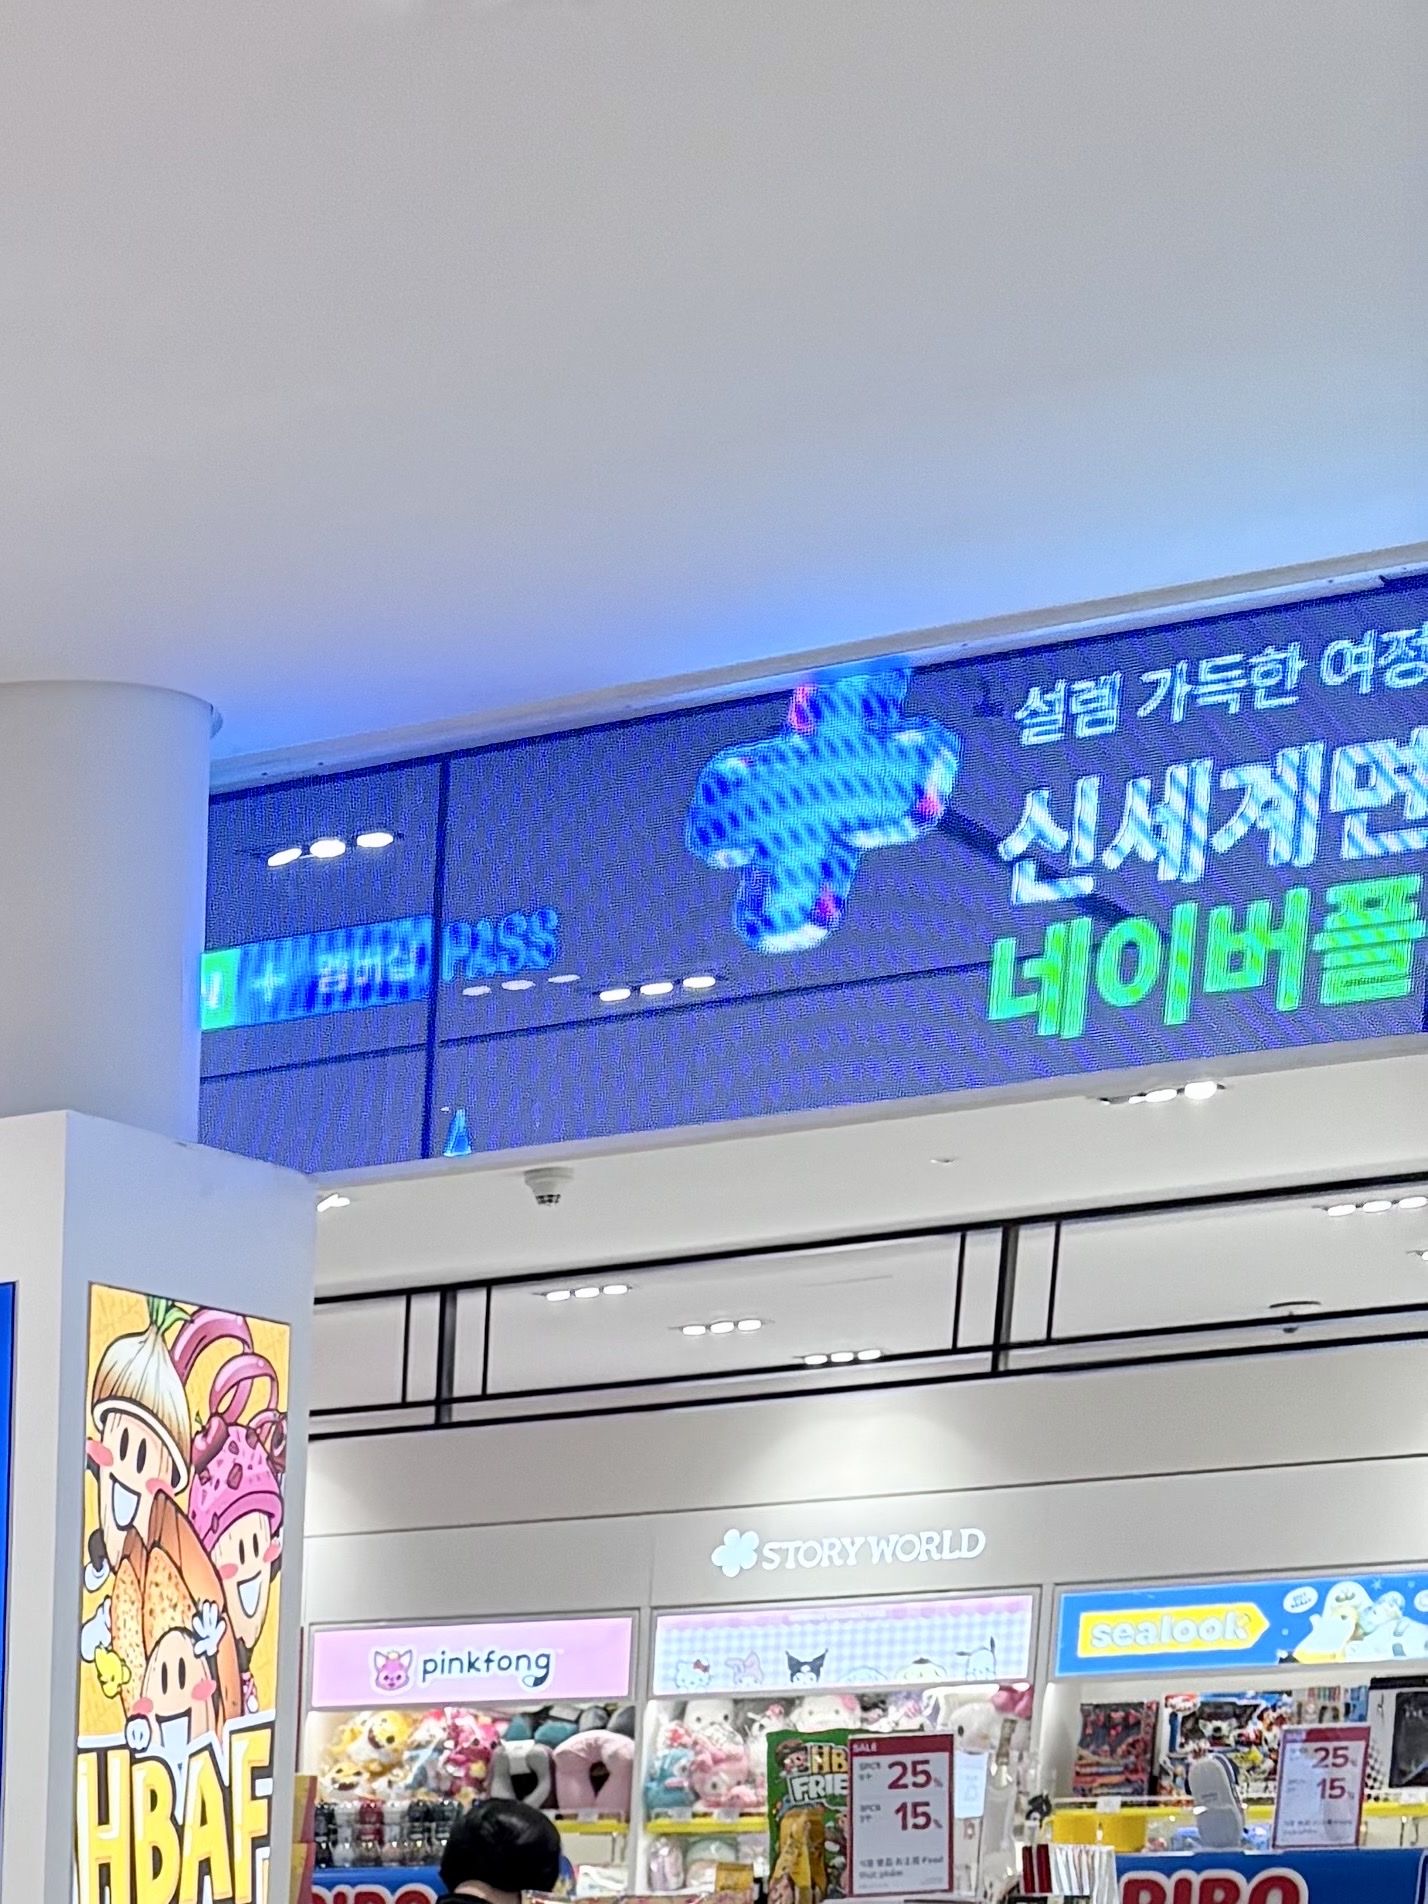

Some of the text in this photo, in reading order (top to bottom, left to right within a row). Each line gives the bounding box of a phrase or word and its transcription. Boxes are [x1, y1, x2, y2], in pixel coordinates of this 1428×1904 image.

[1015, 671, 1123, 746] 설렘
[1137, 641, 1308, 724] 가득한
[442, 904, 561, 982] PASS
[987, 872, 1428, 1040] 네이버플
[761, 1526, 986, 1573] STORY WORLD
[1090, 1610, 1254, 1652] sealook
[421, 1646, 553, 1690] pinkfong
